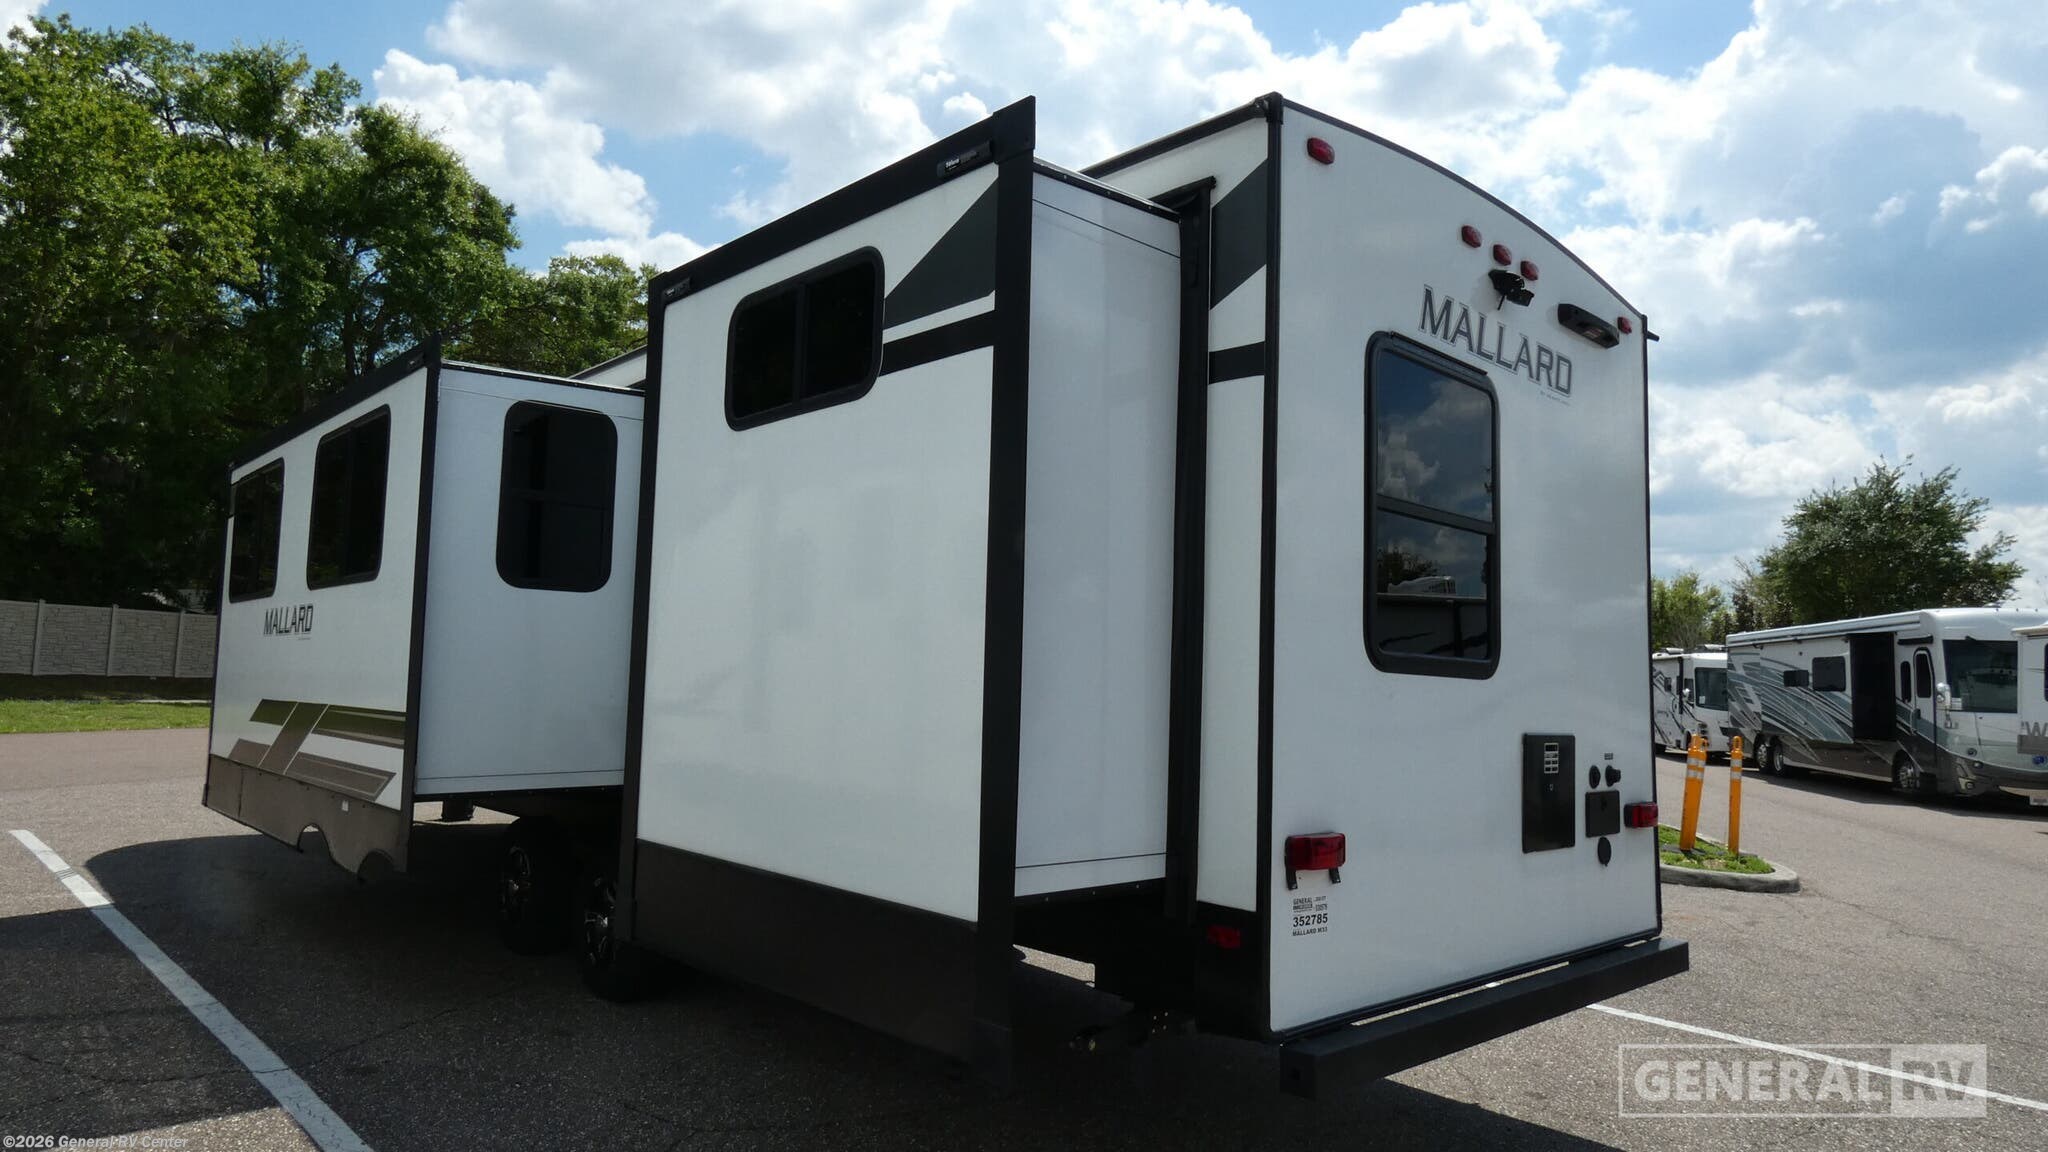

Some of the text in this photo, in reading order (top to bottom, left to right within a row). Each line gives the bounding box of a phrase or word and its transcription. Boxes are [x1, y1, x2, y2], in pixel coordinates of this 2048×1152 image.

[1419, 284, 1573, 398] MALLARD
[264, 604, 314, 635] MALLARD
[1293, 913, 1328, 927] 352785
[1292, 928, 1317, 936] MALLARD
